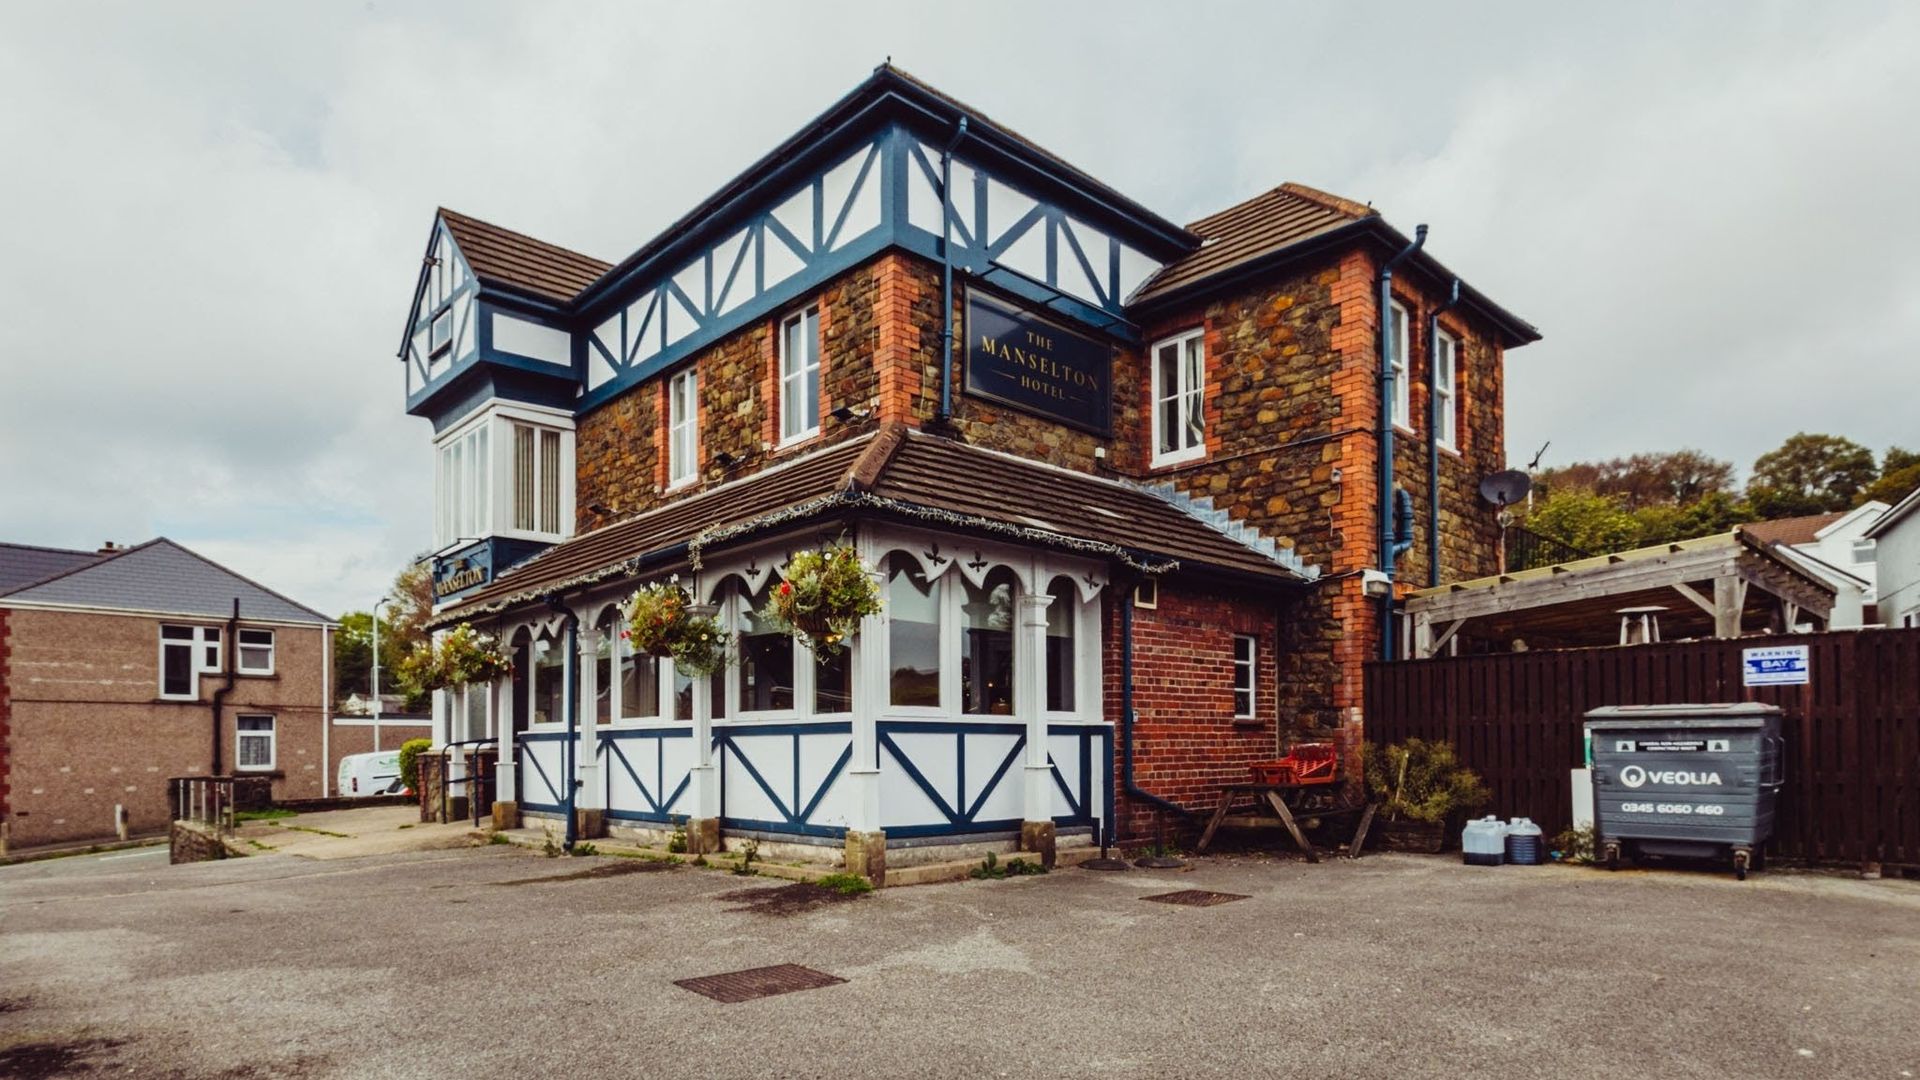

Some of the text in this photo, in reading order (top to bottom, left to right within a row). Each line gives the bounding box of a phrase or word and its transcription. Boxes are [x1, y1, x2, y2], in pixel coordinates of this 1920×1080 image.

[1026, 331, 1053, 351] THE
[982, 335, 1098, 390] MANSELTON
[1021, 375, 1065, 400] HOTEL
[1761, 660, 1788, 668] BAY
[1648, 771, 1722, 785] VEOLIA
[1622, 803, 1724, 814] 0345 6060 460
